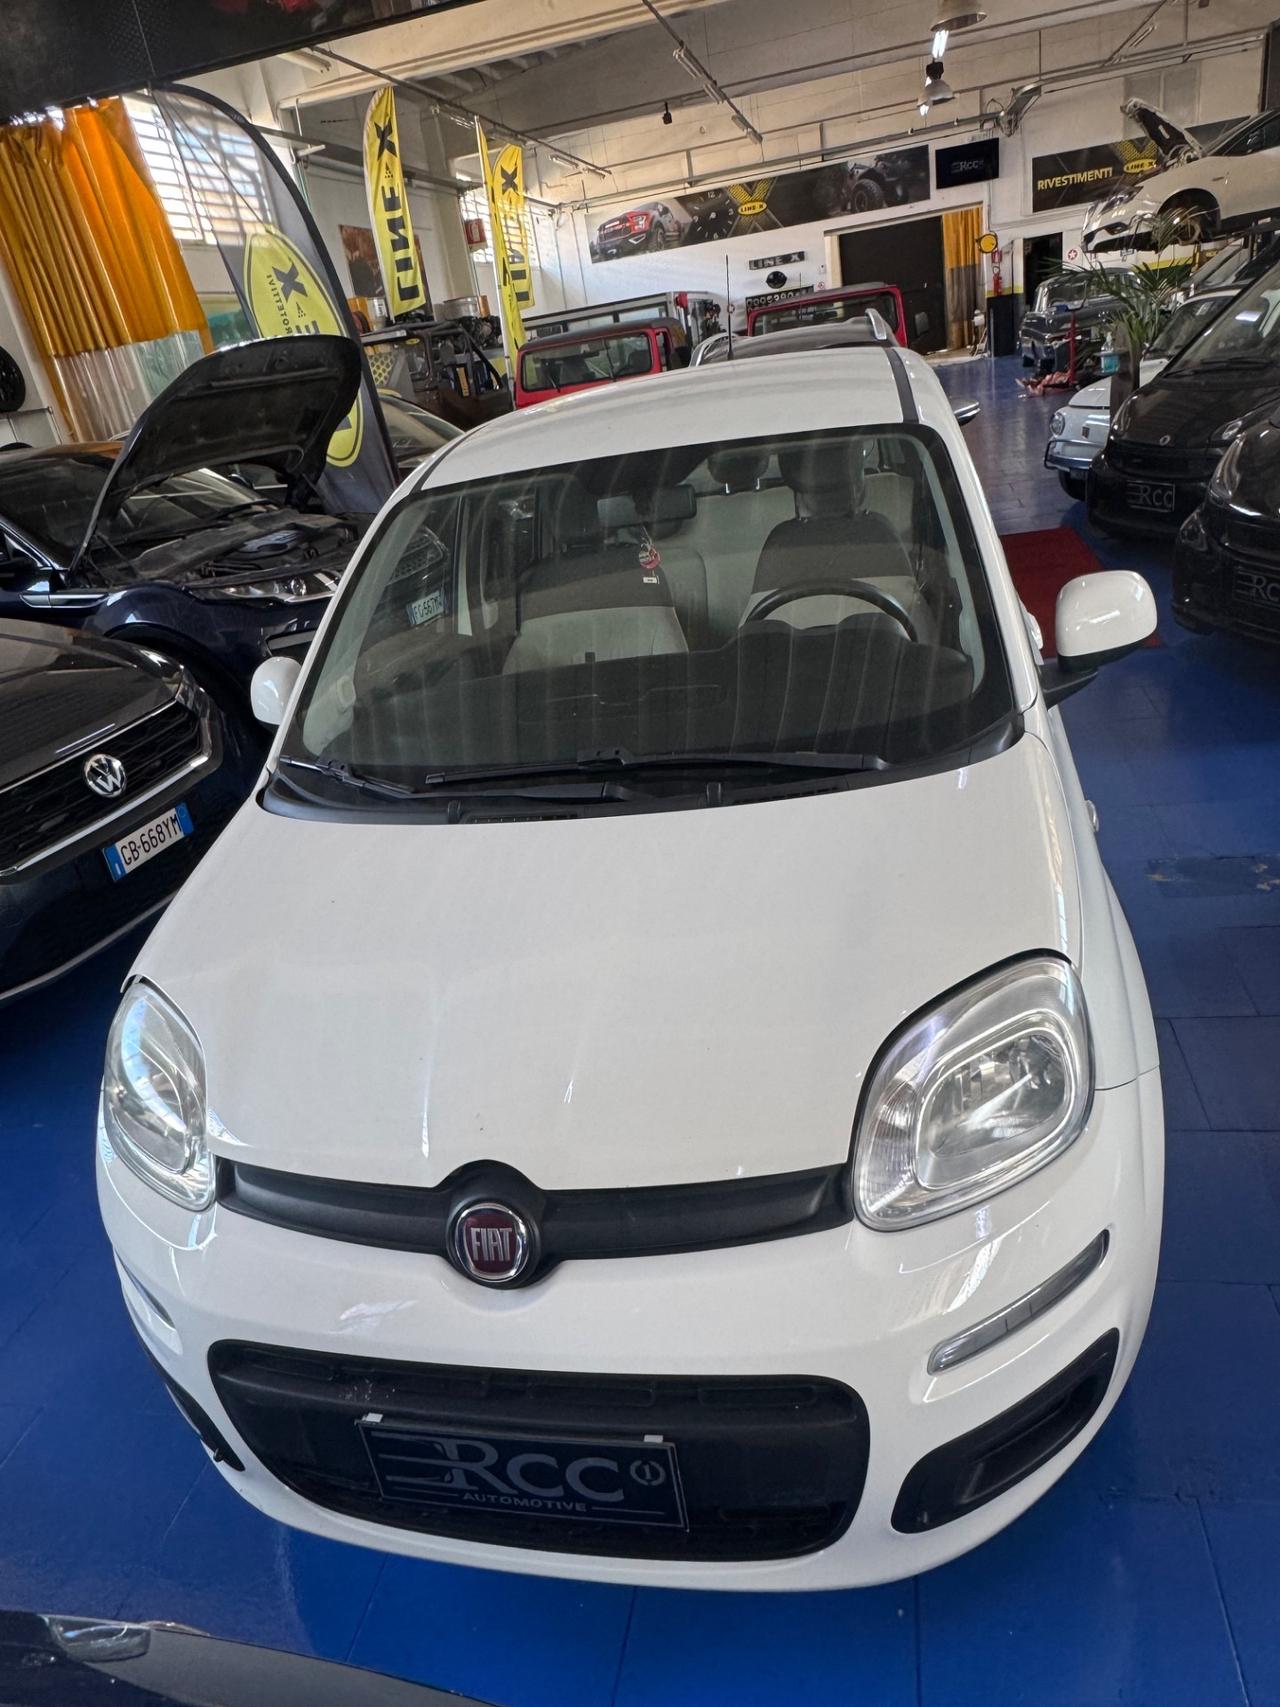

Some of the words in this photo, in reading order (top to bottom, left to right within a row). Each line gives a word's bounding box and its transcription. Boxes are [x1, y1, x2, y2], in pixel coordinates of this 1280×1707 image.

[1037, 166, 1113, 191] RIVESTIMENTI
[470, 1227, 513, 1262] FIAT
[432, 1436, 625, 1503] RCC
[462, 1491, 588, 1514] AUTOMOTIVE
